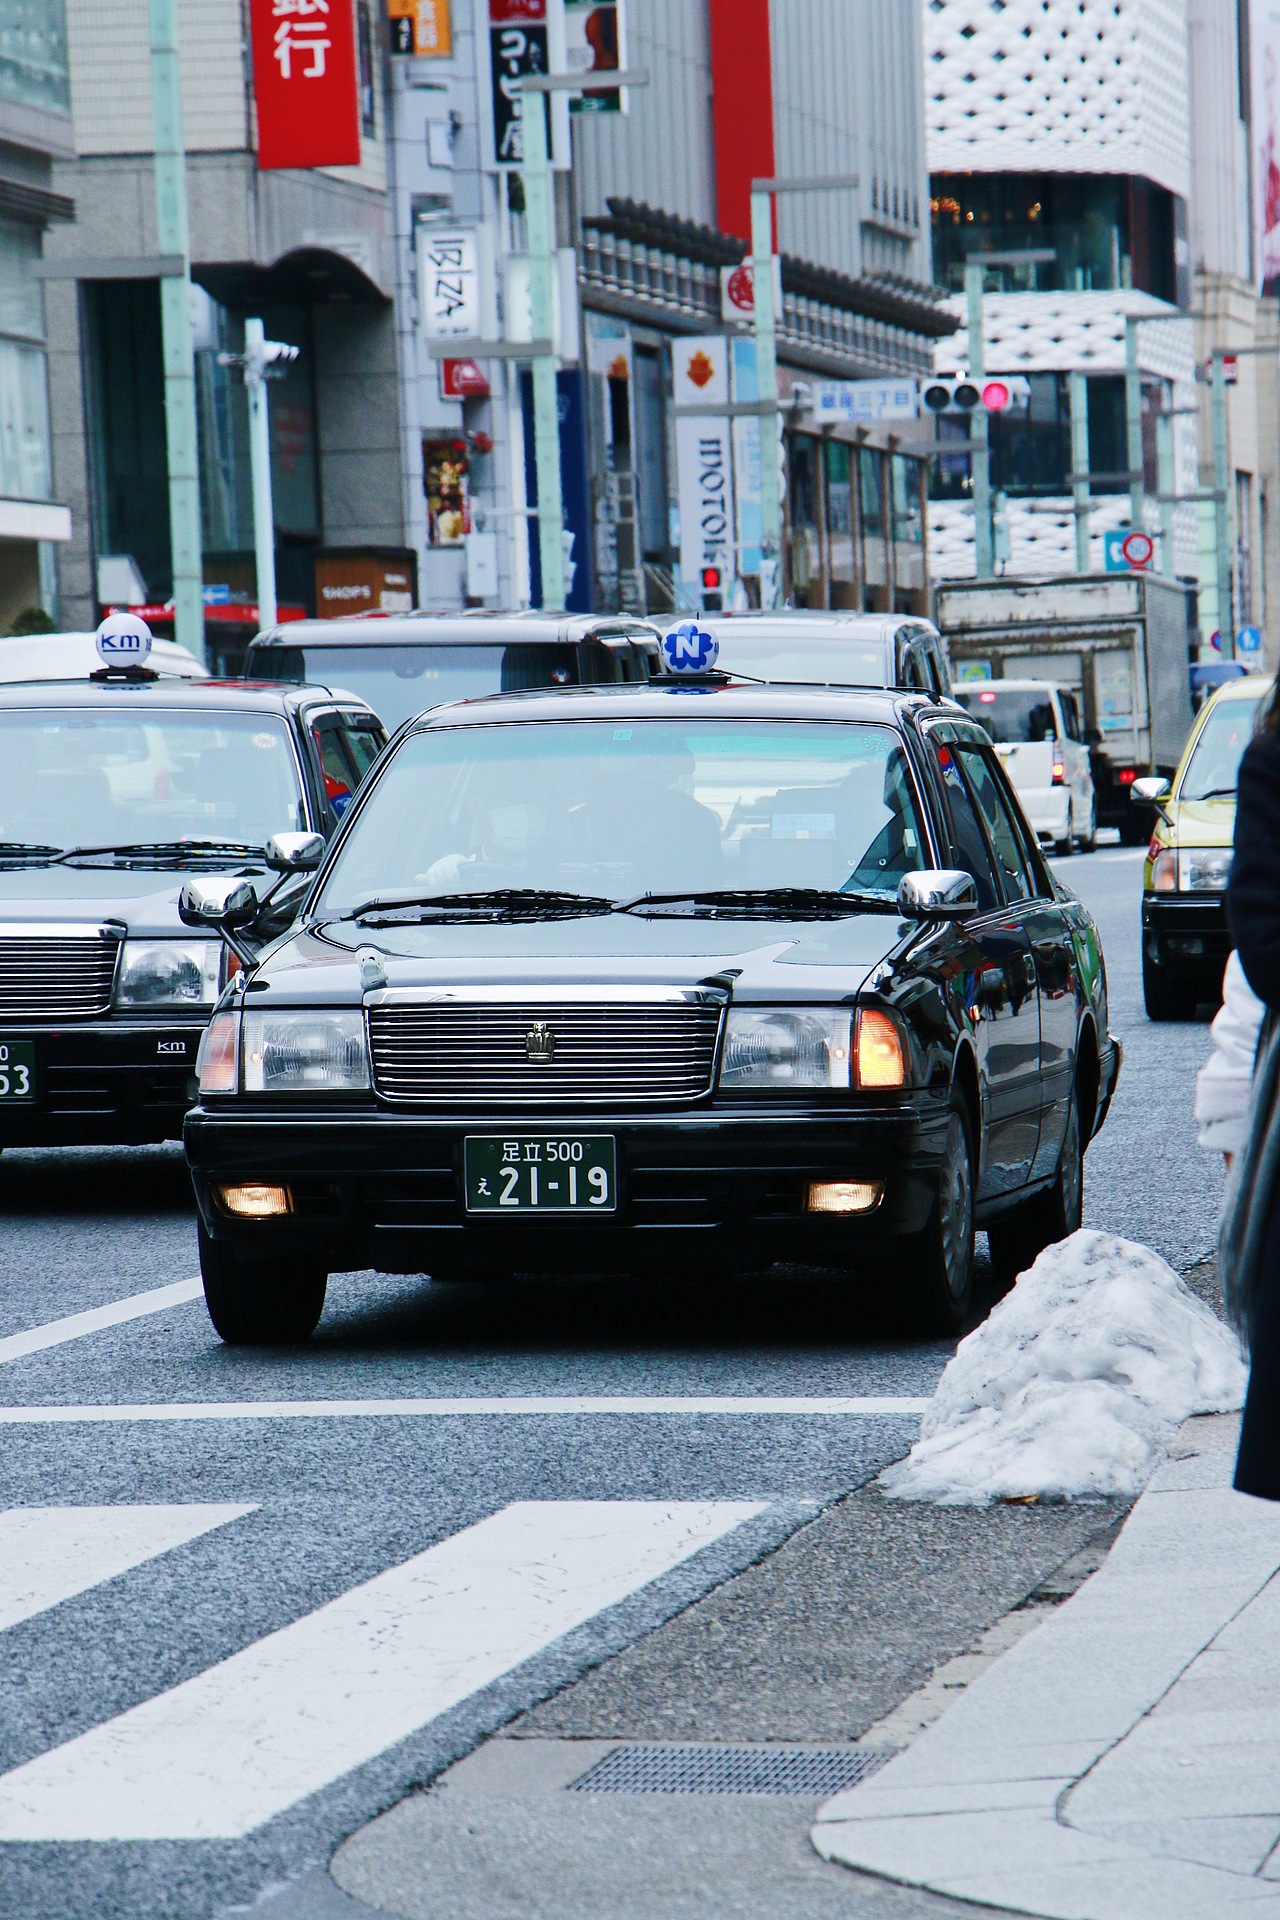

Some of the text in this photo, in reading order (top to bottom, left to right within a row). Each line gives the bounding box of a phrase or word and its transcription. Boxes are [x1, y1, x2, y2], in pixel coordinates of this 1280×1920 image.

[272, 0, 332, 79] 行
[322, 585, 371, 600] SHOPS
[676, 635, 700, 659] N
[502, 1141, 583, 1162] 足立 500
[499, 1166, 609, 1206] 21-19
